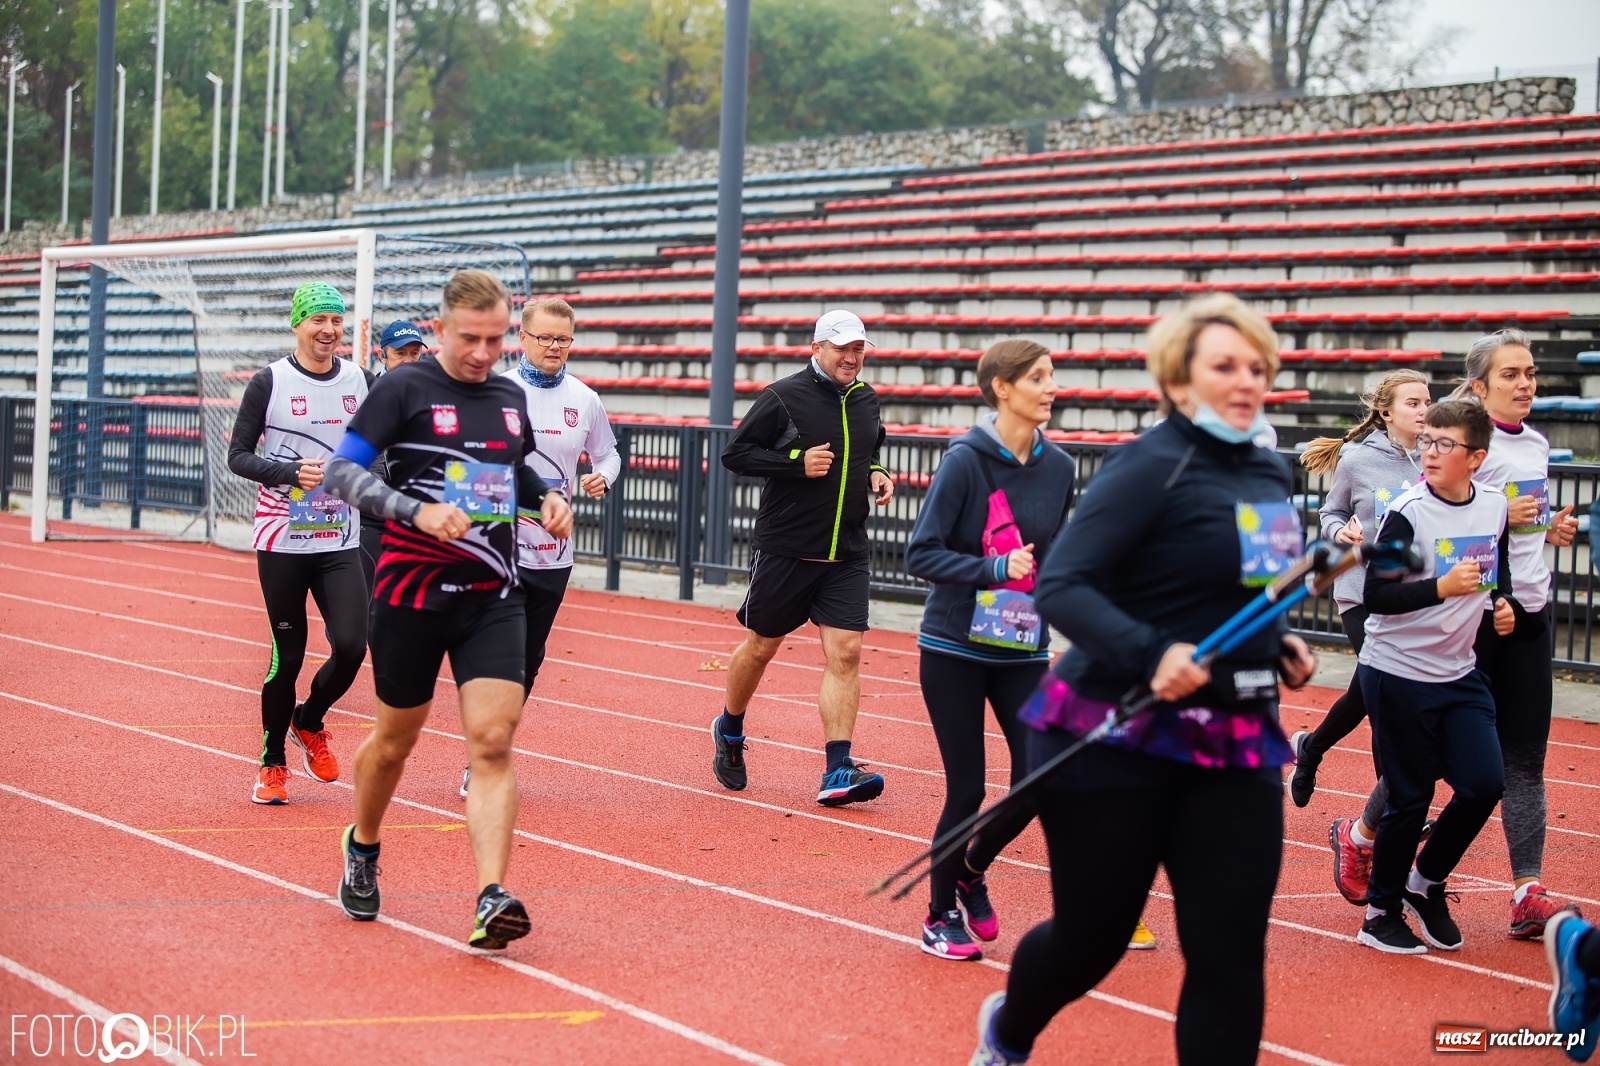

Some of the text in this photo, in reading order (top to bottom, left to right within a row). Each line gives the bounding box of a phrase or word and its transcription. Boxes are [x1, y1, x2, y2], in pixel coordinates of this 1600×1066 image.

[394, 328, 420, 338] adidas
[491, 502, 511, 515] 312
[325, 513, 342, 524] 091
[1016, 630, 1035, 643] 031
